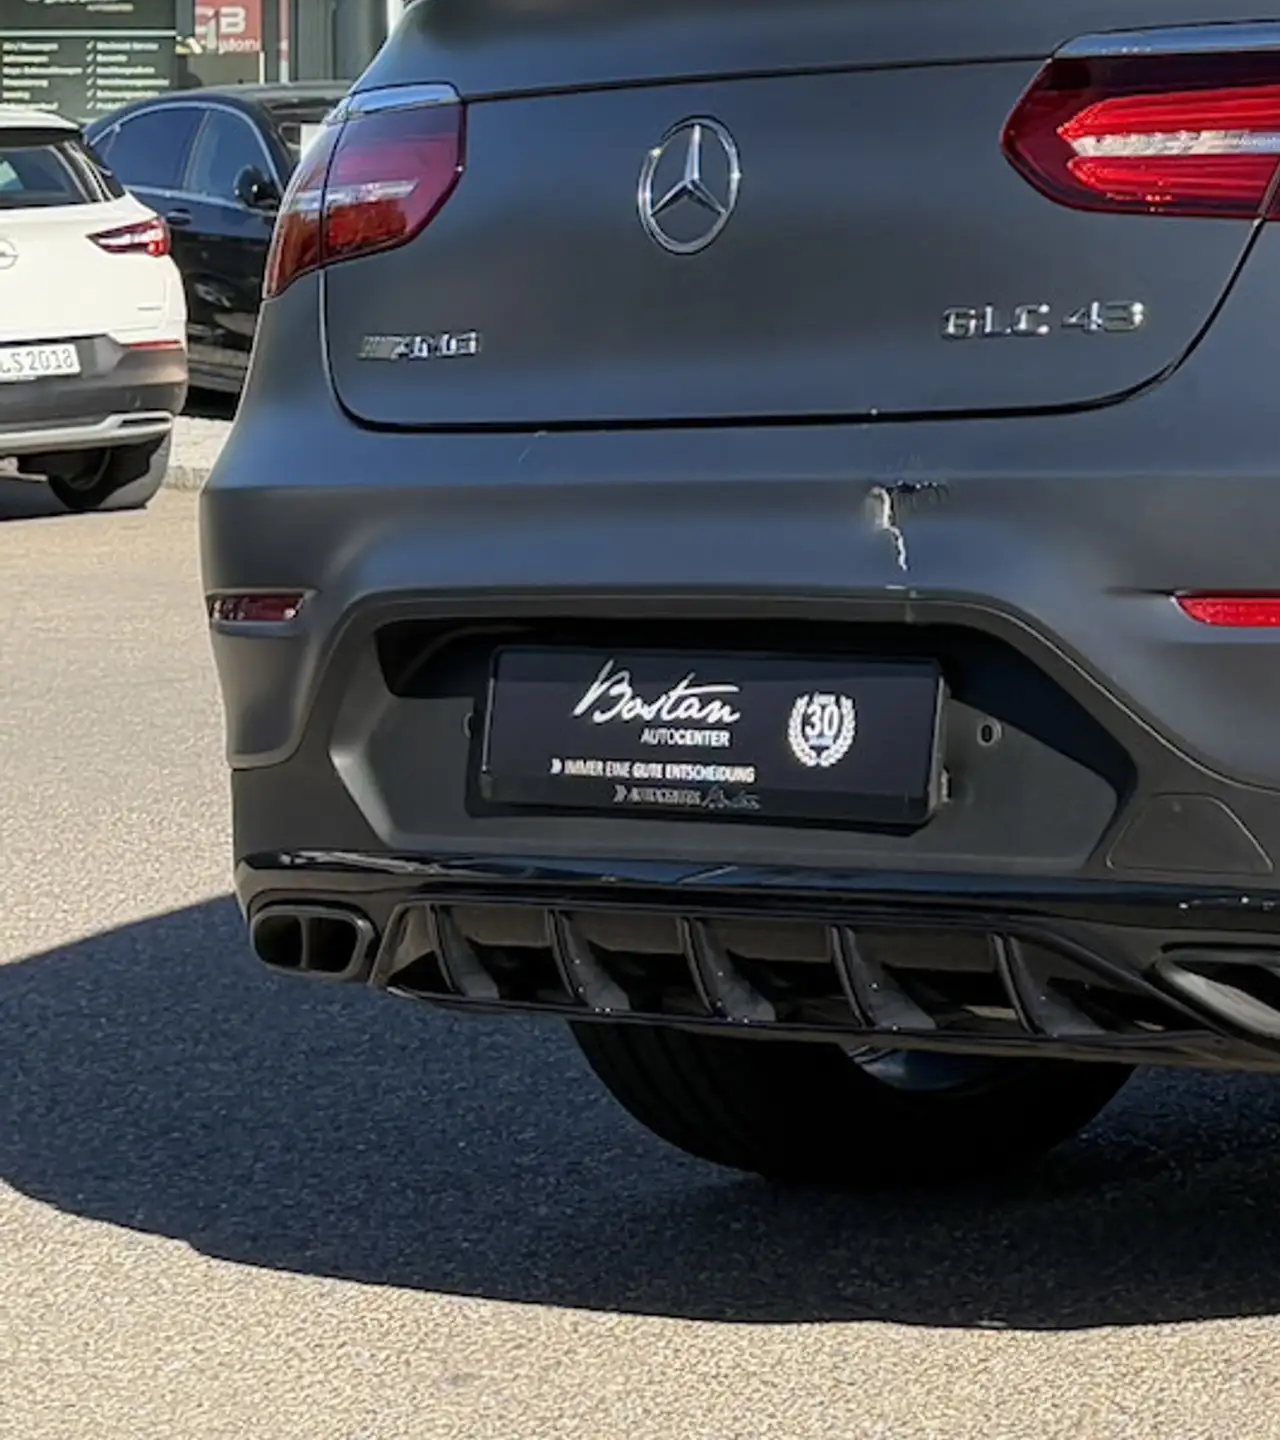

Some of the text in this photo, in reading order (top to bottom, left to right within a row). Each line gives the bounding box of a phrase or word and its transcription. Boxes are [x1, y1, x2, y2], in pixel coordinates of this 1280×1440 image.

[942, 299, 1147, 336] GLC 43
[571, 659, 742, 725] Bostan
[806, 704, 838, 736] 30
[641, 727, 731, 748] AUTOCENTER
